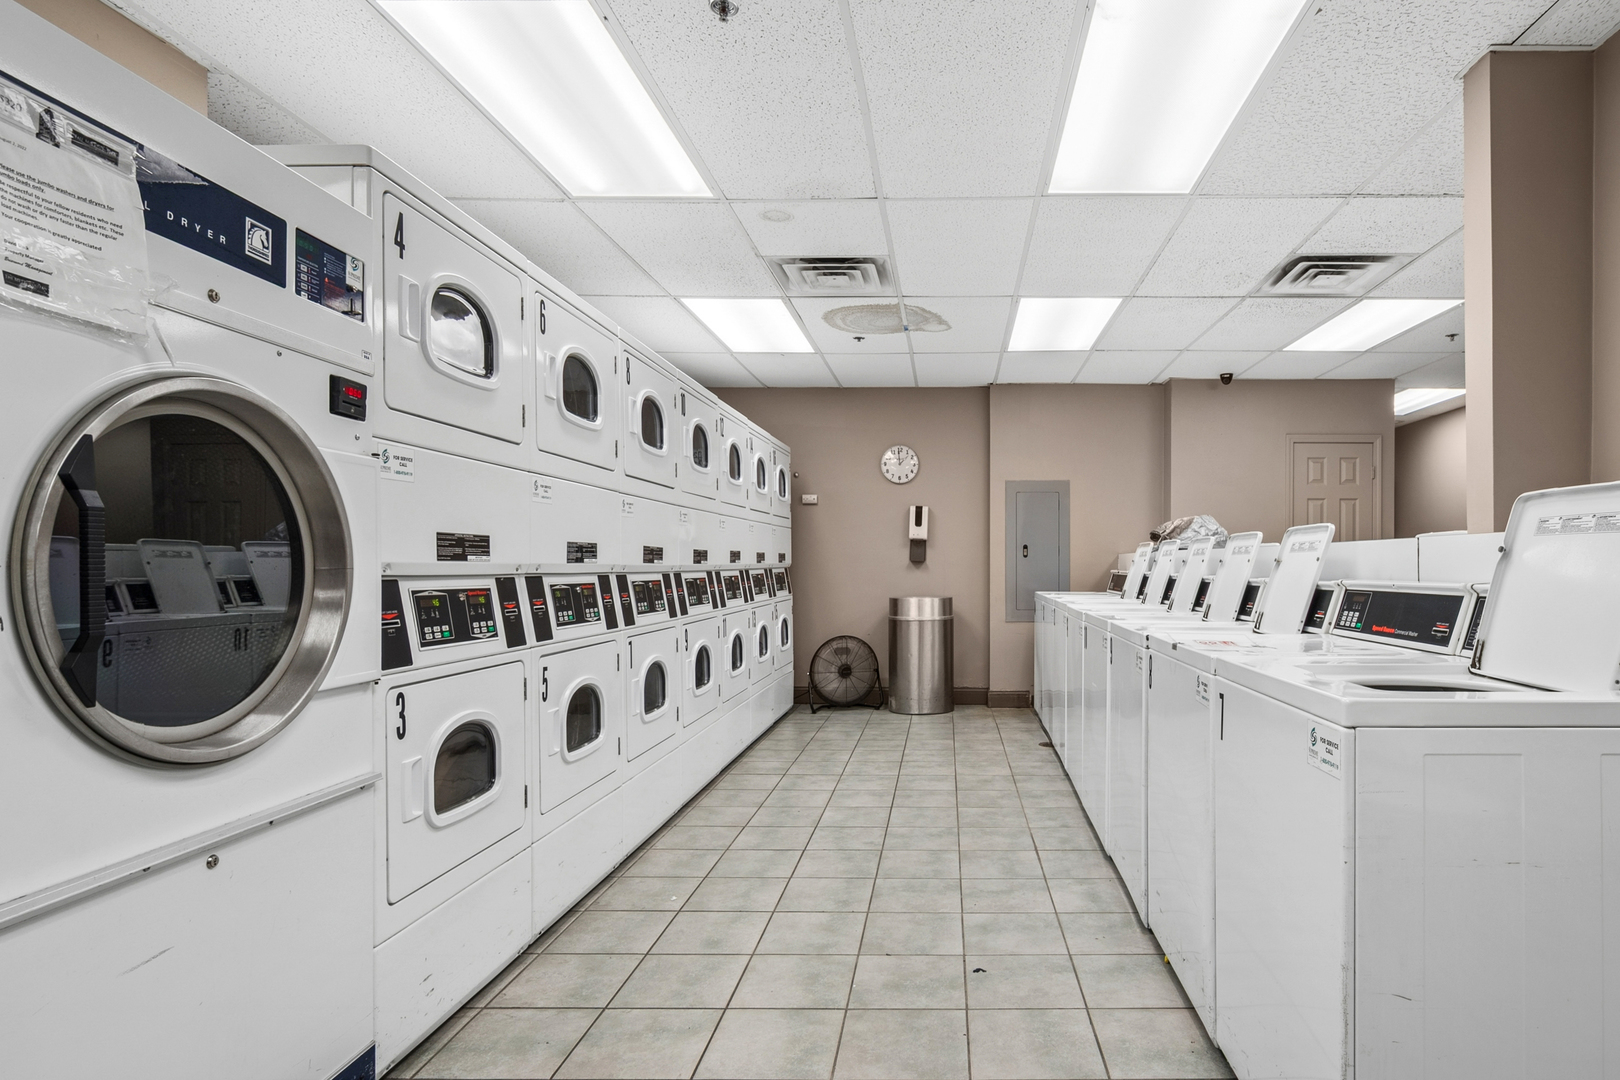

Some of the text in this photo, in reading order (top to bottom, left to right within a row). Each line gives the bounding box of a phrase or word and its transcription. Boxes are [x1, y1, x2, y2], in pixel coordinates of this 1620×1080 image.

[16, 177, 31, 187] loads
[16, 170, 25, 178] use
[37, 178, 55, 191] jumbo
[55, 187, 76, 199] washers
[77, 195, 87, 203] and
[88, 199, 106, 210] dryers
[6, 183, 33, 197] respectful
[41, 197, 53, 205] your
[54, 201, 70, 211] fellow
[71, 209, 96, 221] residents
[97, 217, 109, 225] who
[110, 221, 123, 230] need
[9, 192, 34, 205] machines
[74, 216, 98, 228] blankets
[110, 227, 124, 237] These
[17, 202, 31, 212] wash
[75, 223, 88, 232] than
[100, 232, 118, 241] regular
[14, 217, 48, 232] cooperation
[52, 231, 70, 242] greatly
[167, 210, 226, 245] DRYER
[394, 211, 405, 260] 4
[540, 299, 546, 335] 6
[626, 356, 630, 386] 8
[542, 667, 548, 702] 5
[395, 691, 406, 740] 3
